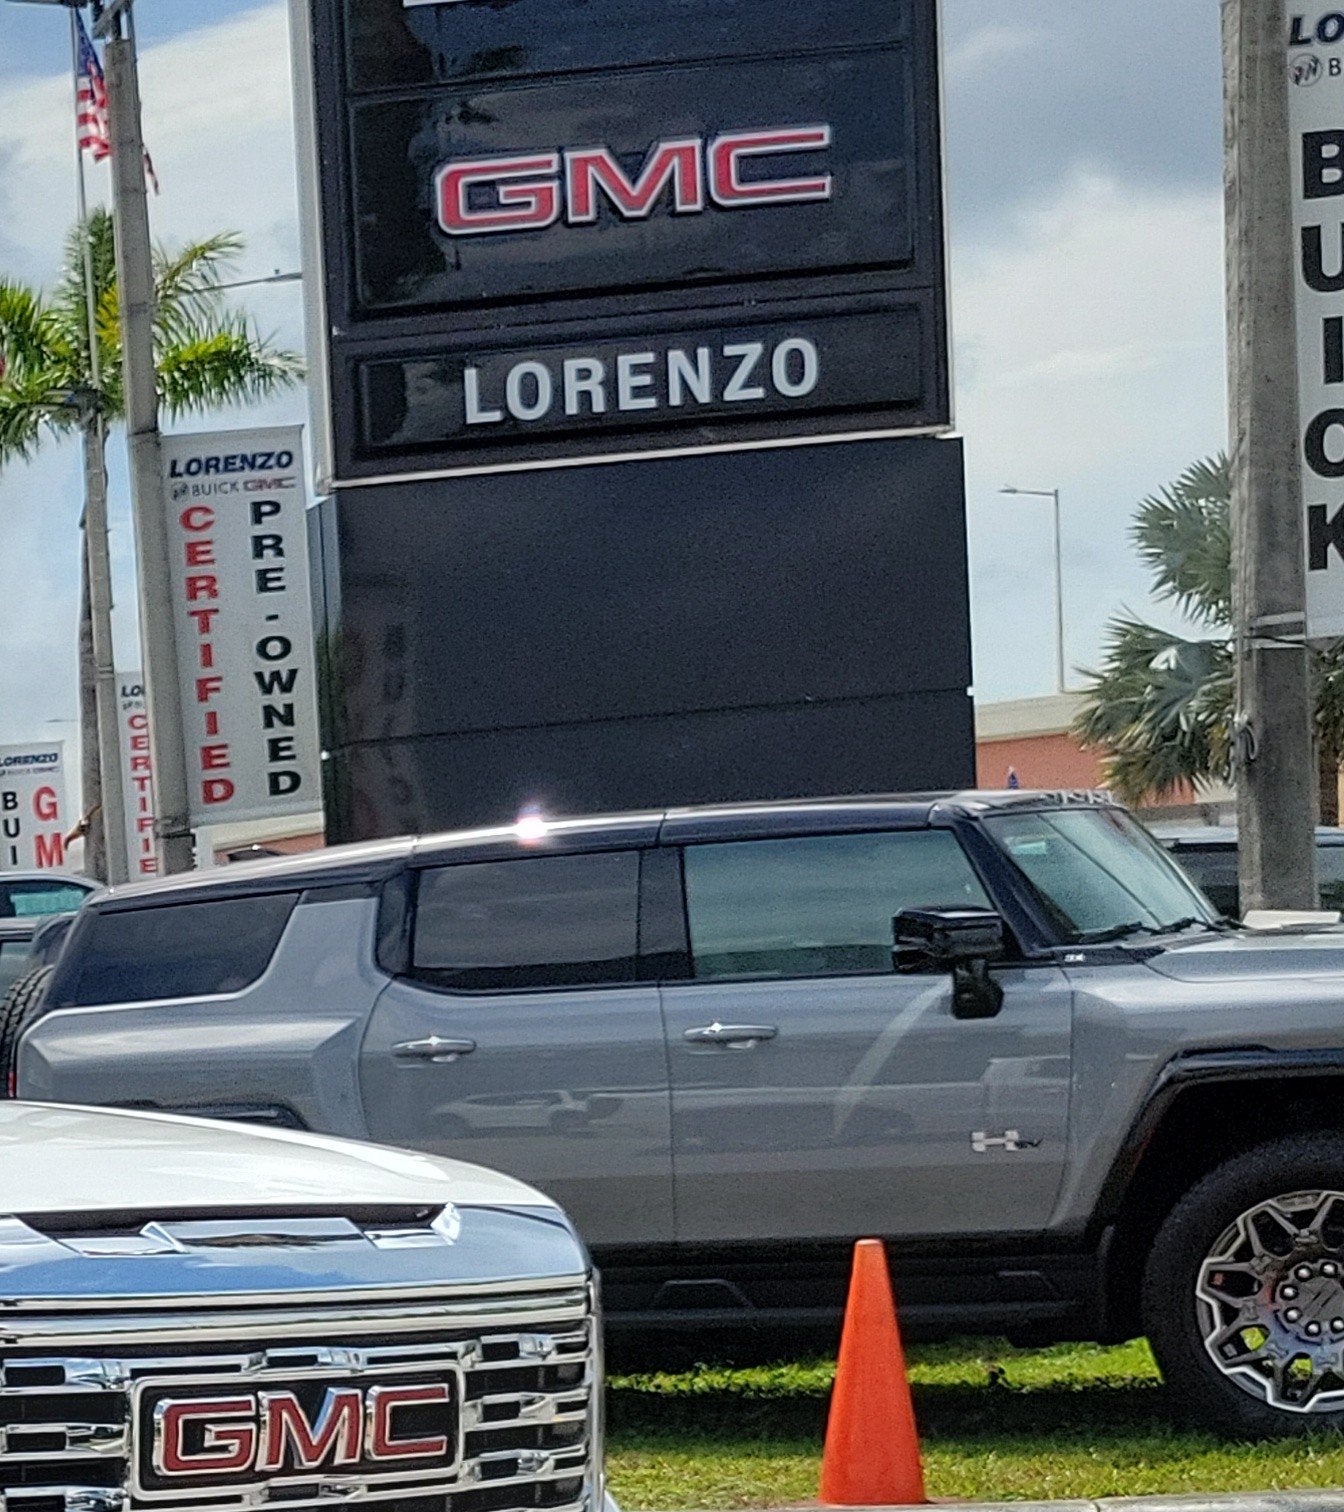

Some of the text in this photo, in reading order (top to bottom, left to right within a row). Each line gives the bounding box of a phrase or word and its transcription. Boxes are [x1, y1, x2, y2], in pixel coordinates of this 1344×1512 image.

[435, 124, 831, 236] GMC
[463, 337, 819, 425] LORENZO
[170, 450, 293, 478] LORENZO
[192, 476, 297, 497] BUICK GMC
[179, 506, 235, 804] CERTIFIED
[250, 501, 302, 796] PRE-OWNED
[127, 715, 159, 874] CERTIFIE
[153, 1383, 450, 1477] GMC
